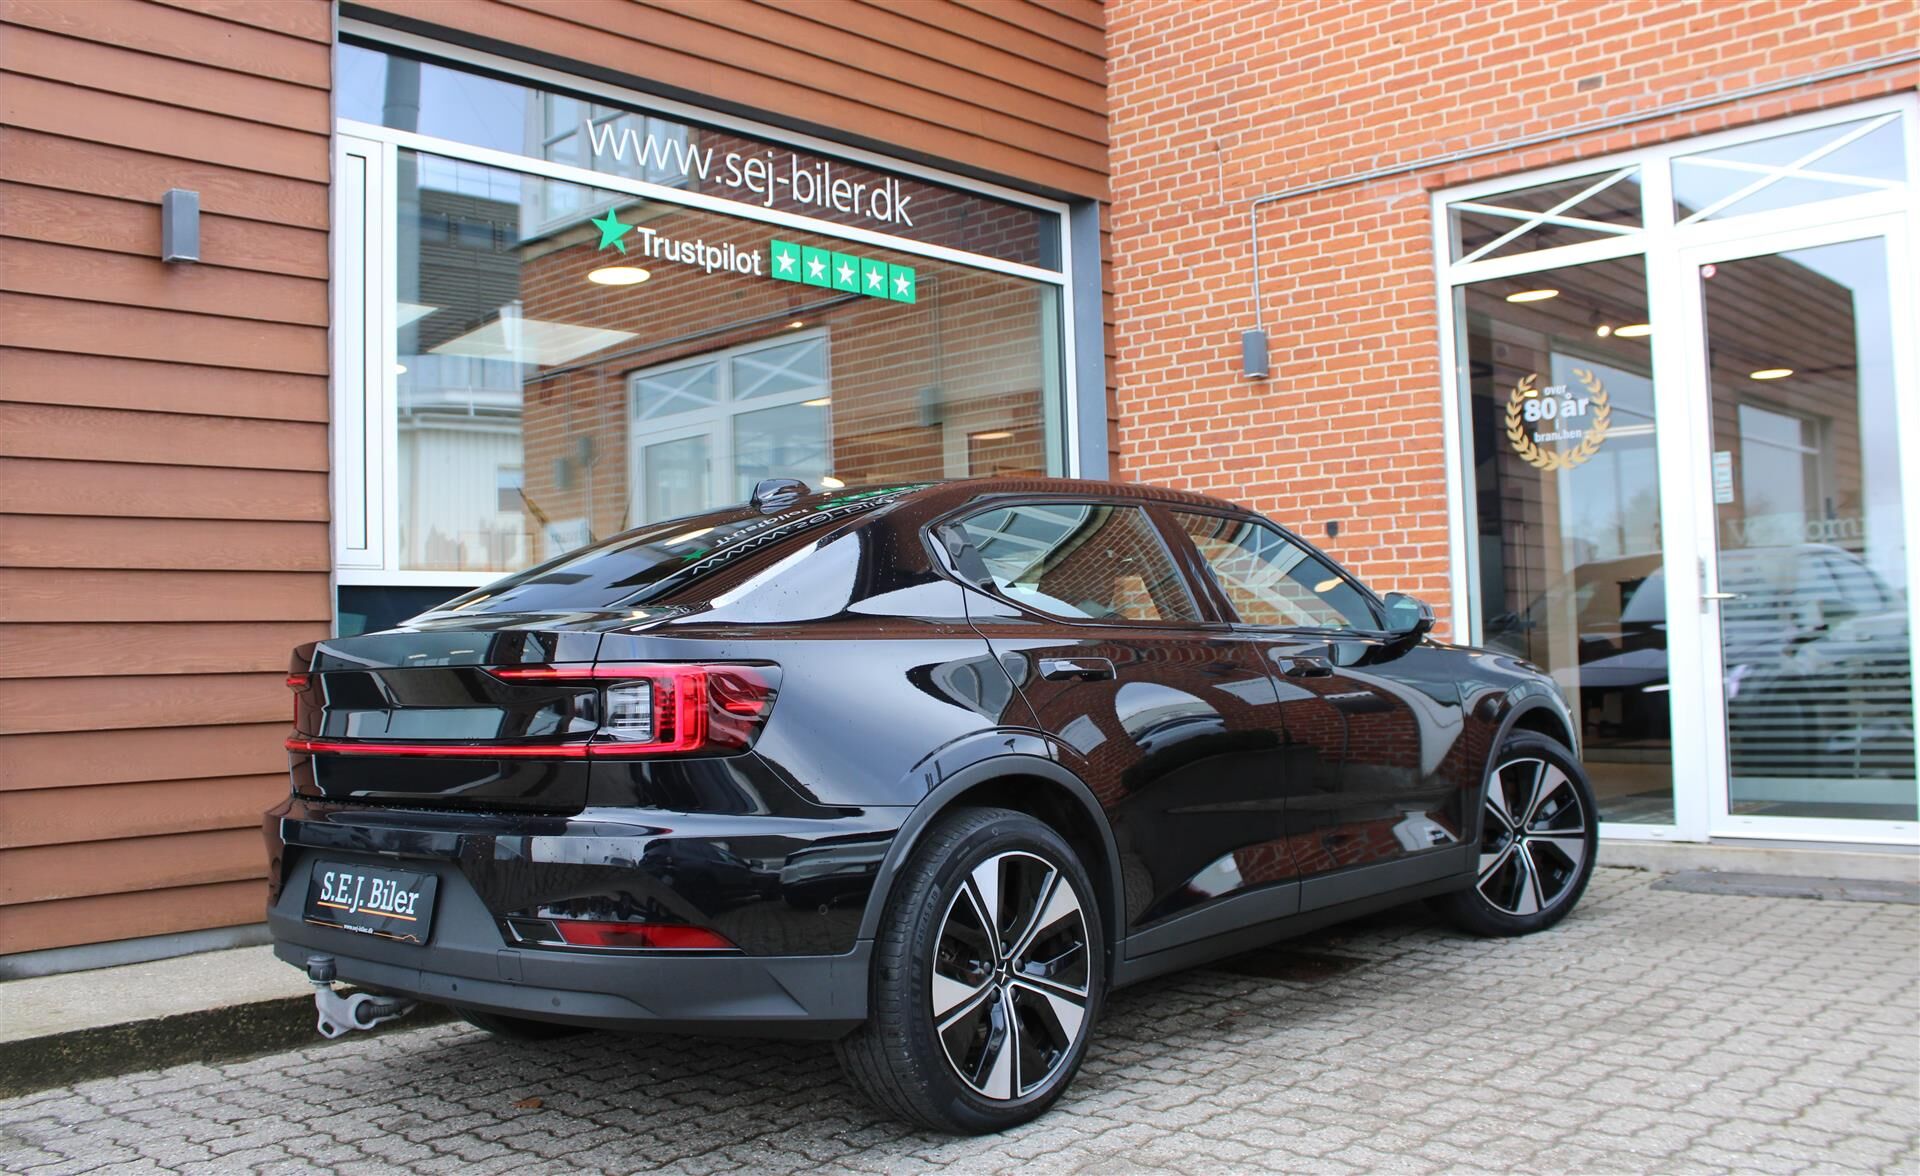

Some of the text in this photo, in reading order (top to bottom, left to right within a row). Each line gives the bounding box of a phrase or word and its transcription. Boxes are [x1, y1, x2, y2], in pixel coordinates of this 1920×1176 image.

[586, 119, 914, 227] www.sej-biler.dk
[637, 226, 762, 276] Trustpilot
[1523, 392, 1589, 422] 80 år
[1543, 384, 1568, 396] over
[320, 871, 420, 915] S.E.J. Biler
